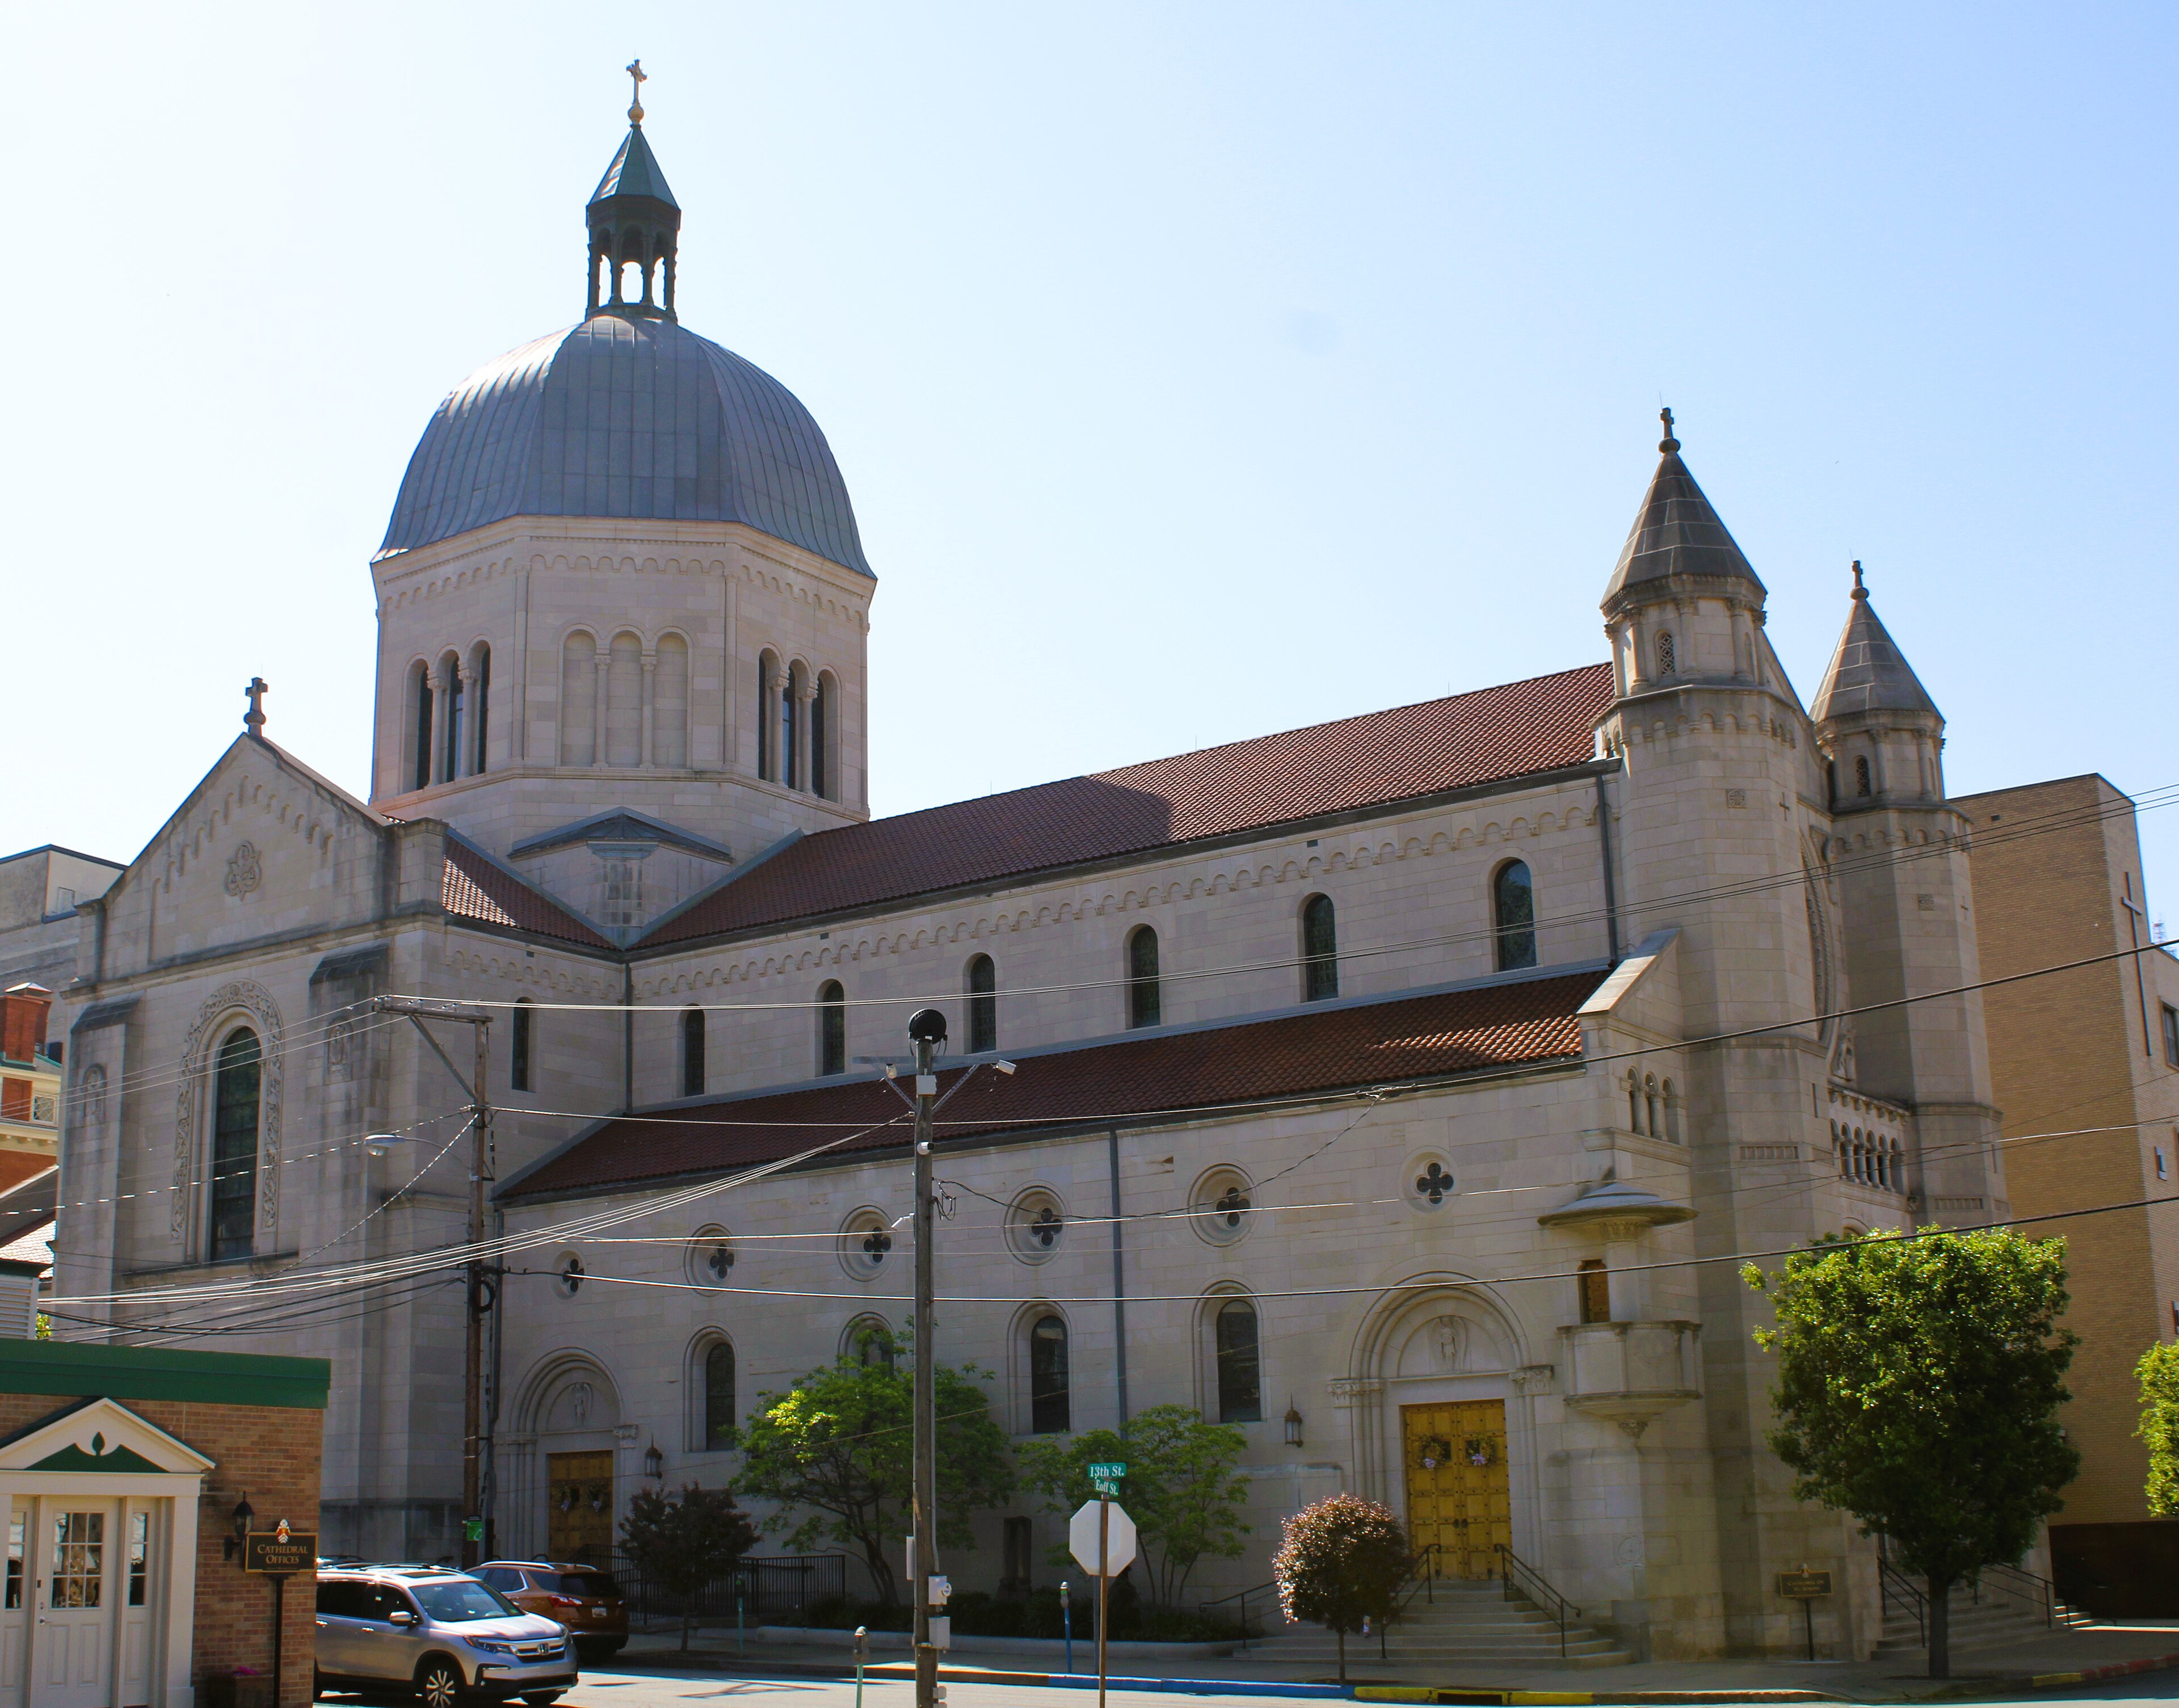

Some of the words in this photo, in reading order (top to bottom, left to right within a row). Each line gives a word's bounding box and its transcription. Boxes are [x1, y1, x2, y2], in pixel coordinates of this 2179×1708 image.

[1090, 1466, 1109, 1477] 13th
[1112, 1466, 1124, 1476] St.
[1096, 1479, 1109, 1493] Eoff
[1109, 1483, 1118, 1495] St.
[257, 1544, 308, 1554] CATHEDRAL
[266, 1555, 299, 1564] OFFICES
